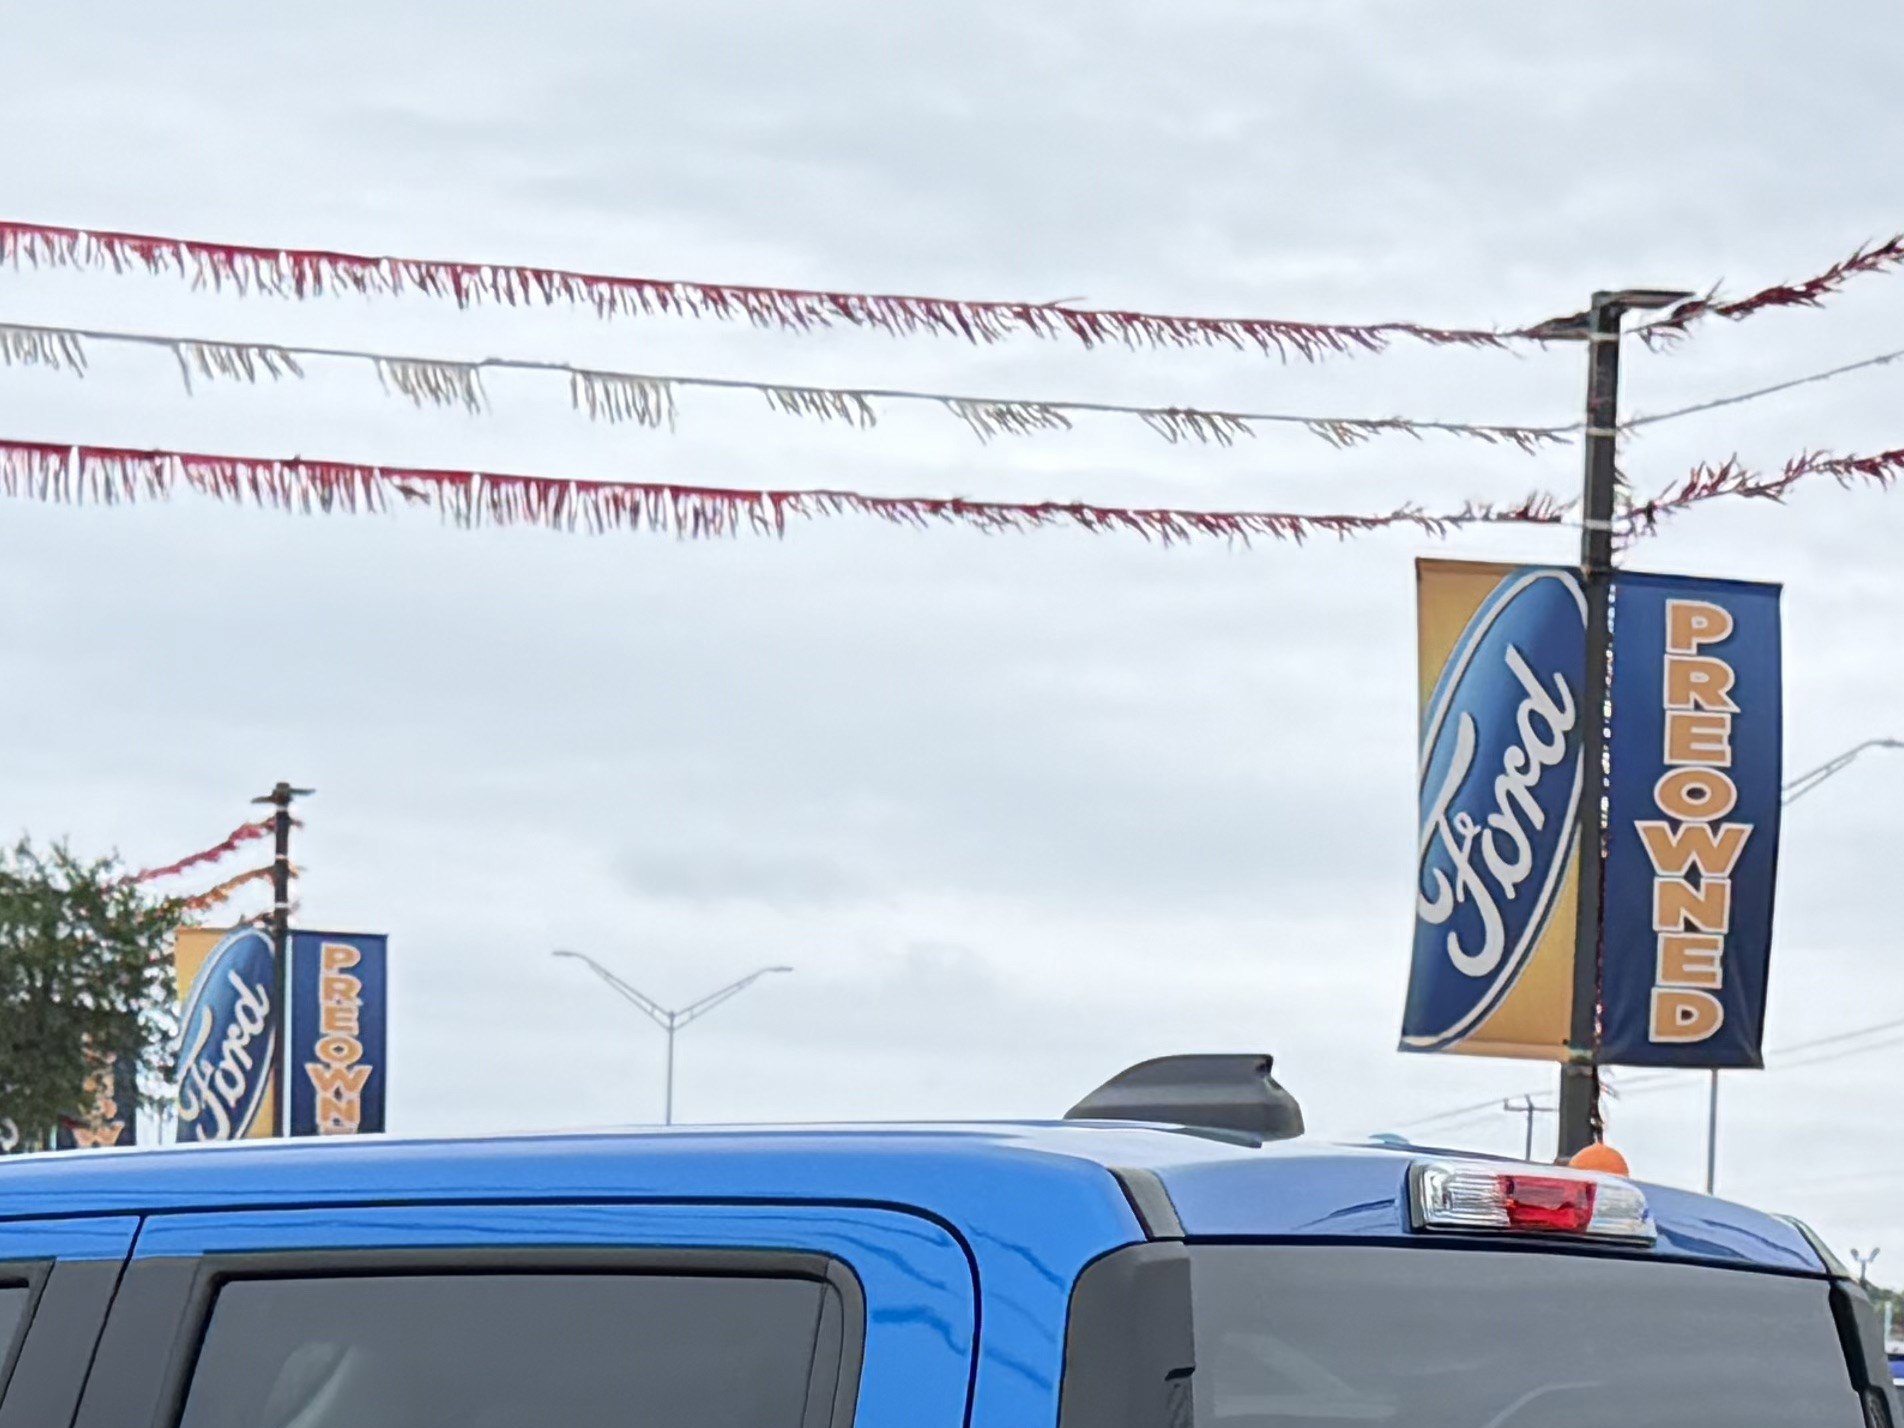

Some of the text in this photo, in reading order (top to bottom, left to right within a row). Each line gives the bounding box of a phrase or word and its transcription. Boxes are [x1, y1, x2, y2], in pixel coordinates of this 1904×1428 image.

[1416, 642, 1577, 977] Ford
[1634, 598, 1755, 1044] PREOWNED
[177, 968, 271, 1143] Ford
[304, 941, 374, 1135] PREOWN
